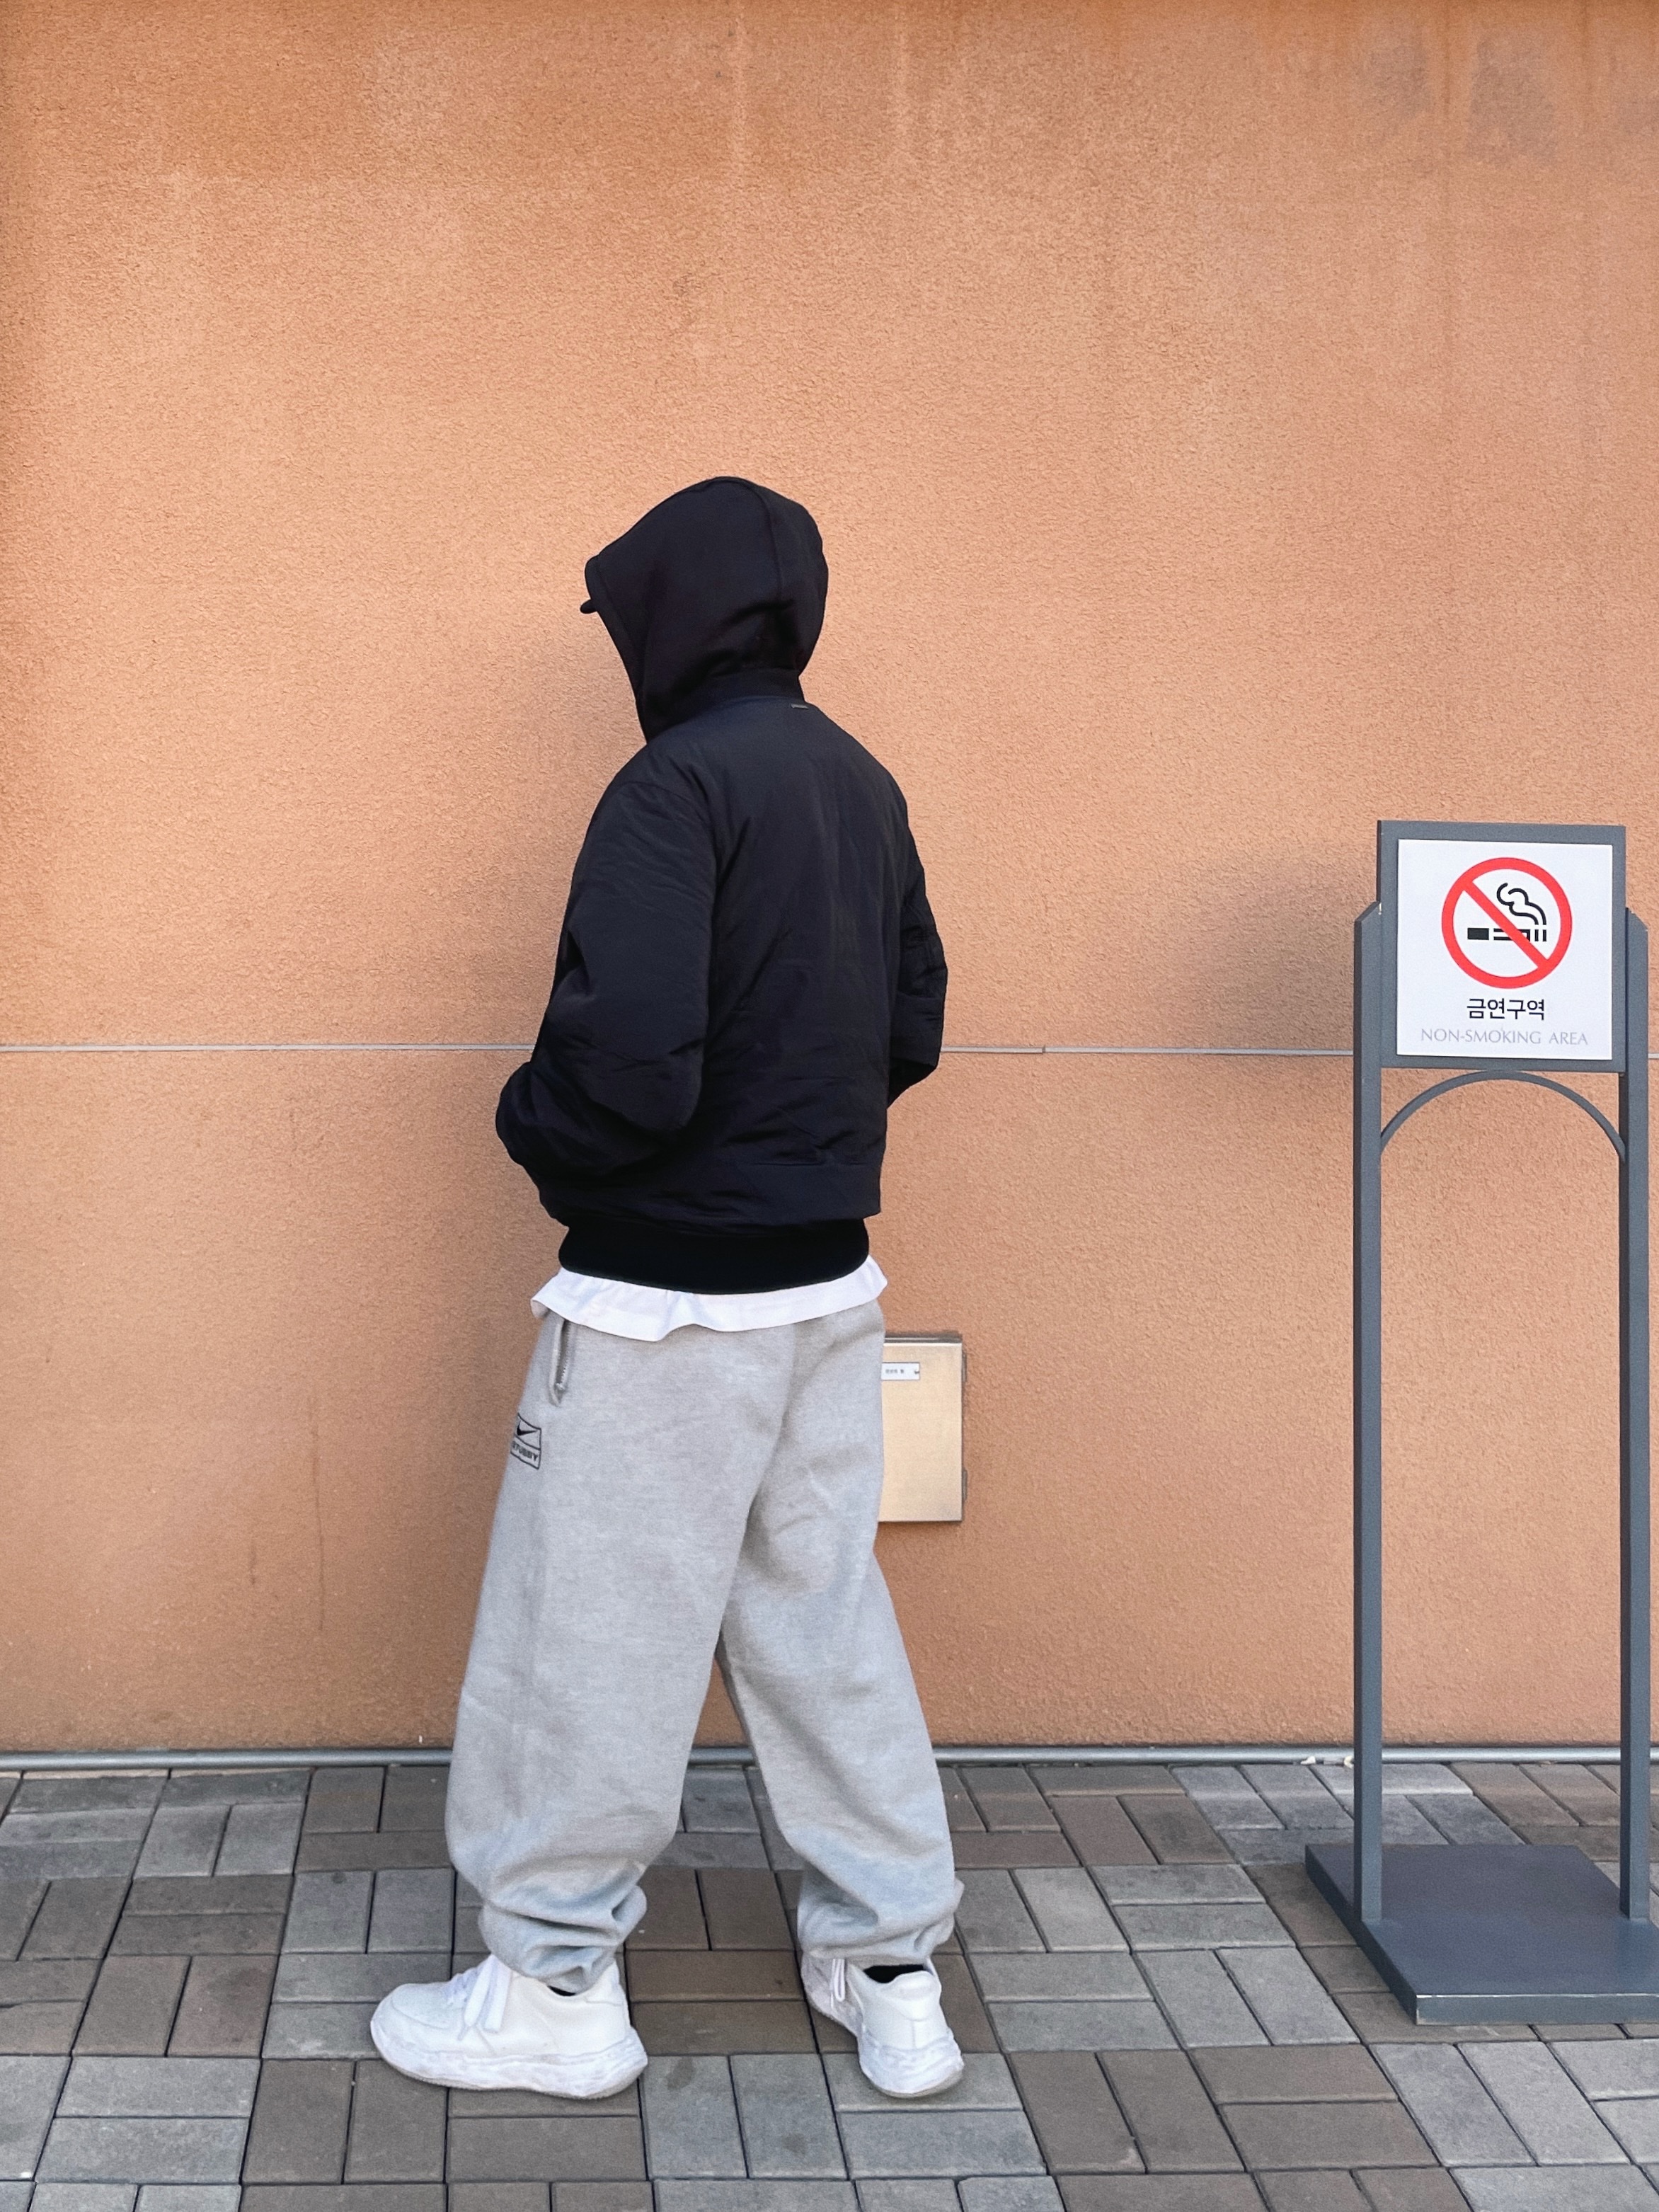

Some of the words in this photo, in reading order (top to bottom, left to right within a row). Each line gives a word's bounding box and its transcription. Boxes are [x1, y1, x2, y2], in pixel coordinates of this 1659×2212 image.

[1466, 997, 1545, 1021] 금연구역
[1420, 1028, 1542, 1045] NON-SMOKING
[1549, 1031, 1588, 1045] AREA
